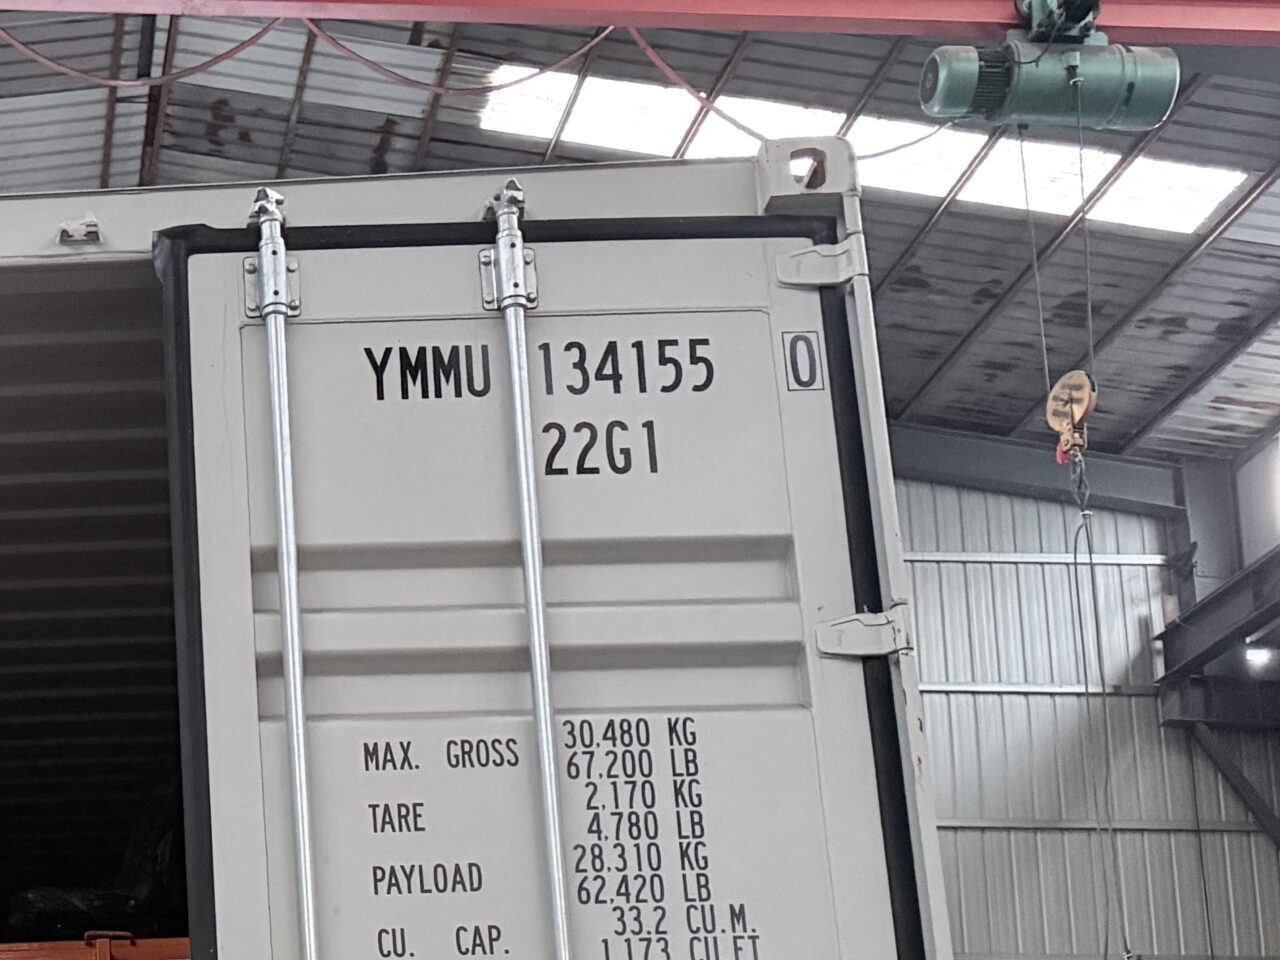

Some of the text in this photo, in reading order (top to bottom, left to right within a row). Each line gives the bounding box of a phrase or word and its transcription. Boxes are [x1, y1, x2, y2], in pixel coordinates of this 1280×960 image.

[364, 334, 818, 400] YMMU 134155 0
[542, 420, 659, 476] 22G1
[562, 716, 697, 750] 30,480 KG
[363, 738, 520, 772] MAX. GROSS
[566, 748, 699, 780] 67,200 LB
[584, 778, 703, 811] 2,170 KG
[367, 802, 426, 834] TARE
[587, 810, 705, 842] 4,780 LB
[573, 841, 709, 874] 28,310 KG
[372, 862, 483, 896] PAYLOAD
[577, 872, 711, 905] 62,420 LB
[612, 903, 757, 936] 33.2 CU.M.
[377, 925, 510, 958] CU. CAP.
